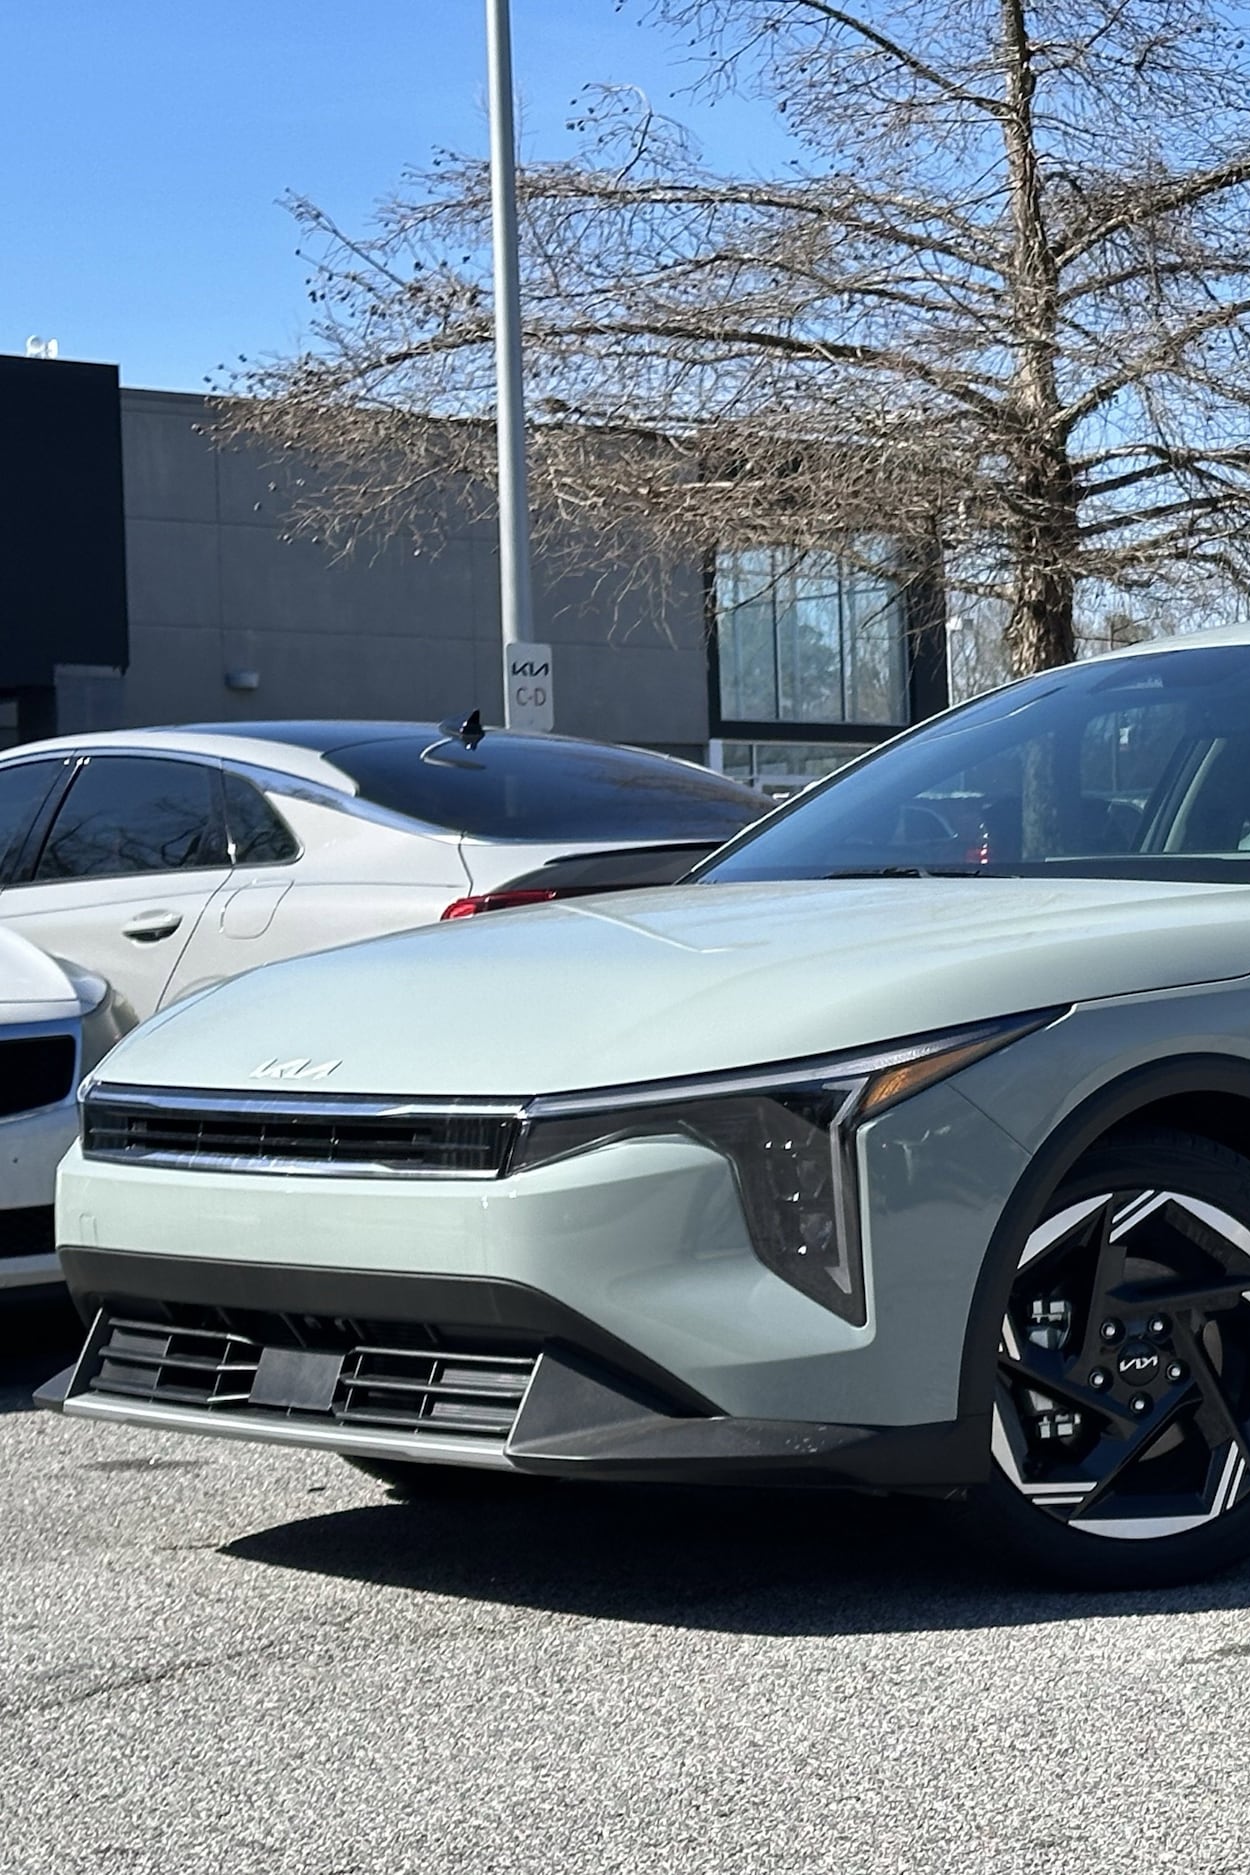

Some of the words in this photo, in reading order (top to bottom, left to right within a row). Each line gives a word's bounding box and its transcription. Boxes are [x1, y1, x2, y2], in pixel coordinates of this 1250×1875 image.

[511, 661, 550, 678] KIA
[516, 687, 547, 707] C-D
[248, 1056, 344, 1080] KIA
